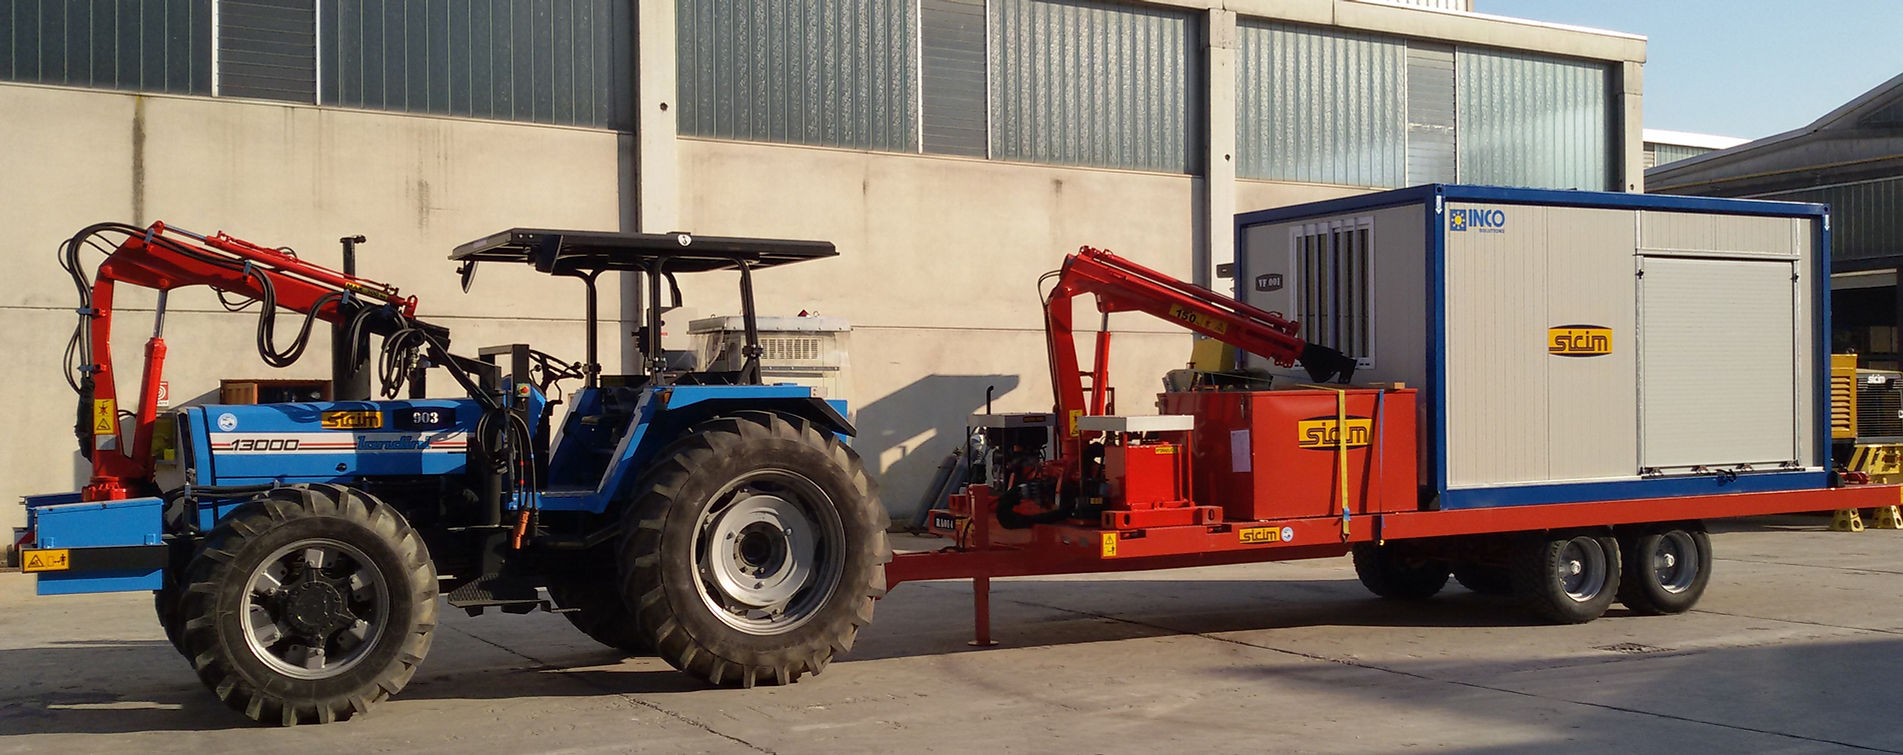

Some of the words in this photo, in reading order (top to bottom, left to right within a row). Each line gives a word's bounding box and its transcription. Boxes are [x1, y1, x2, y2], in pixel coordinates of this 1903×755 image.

[1468, 209, 1505, 227] INCO
[1176, 309, 1197, 323] 150
[1549, 330, 1608, 352] sicim
[413, 411, 439, 424] 903
[230, 439, 299, 451] 13000
